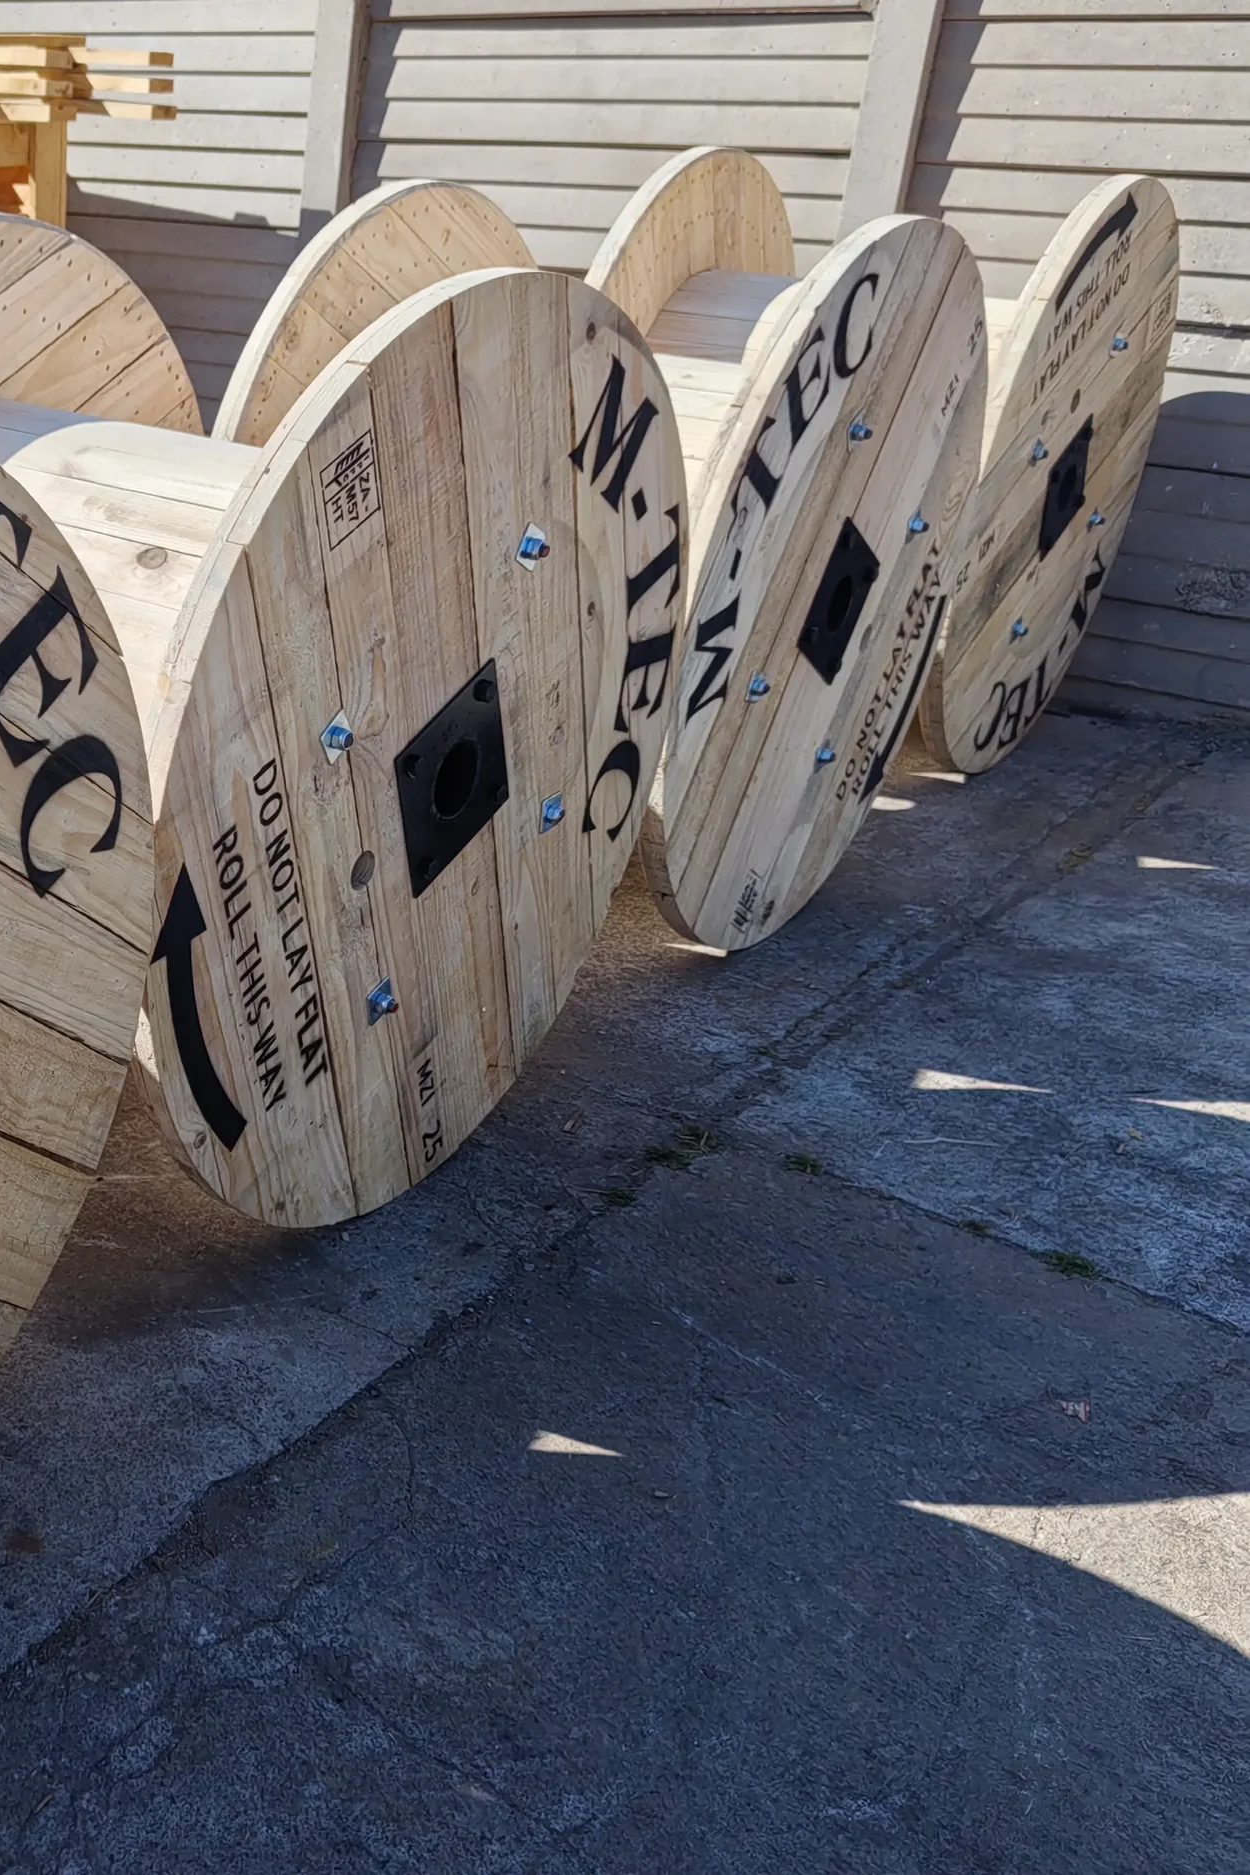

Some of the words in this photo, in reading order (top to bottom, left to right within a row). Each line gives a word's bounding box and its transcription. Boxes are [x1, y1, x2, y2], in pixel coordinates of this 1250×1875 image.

[1076, 271, 1100, 316] THIS
[1087, 285, 1112, 332] NOT
[1114, 262, 1131, 297] DO
[1045, 305, 1073, 357] WAY
[1062, 318, 1087, 366] LAY
[1032, 351, 1061, 406] FLAT
[331, 496, 344, 523] HT
[345, 483, 359, 522] M57
[836, 758, 856, 801] DO
[856, 686, 882, 751] NOT
[882, 621, 905, 683] LAY
[906, 538, 939, 618] FLAT
[852, 724, 886, 795] ROLL
[883, 652, 912, 711] THIS
[911, 568, 941, 640] WAY
[252, 757, 284, 827] DO
[212, 825, 252, 940] ROLL
[265, 829, 300, 915] NOT
[235, 930, 272, 1027] THIS
[281, 915, 313, 994] LAY
[252, 1020, 289, 1113] WAY
[294, 995, 329, 1087] FLAT
[422, 1119, 444, 1163] 25
